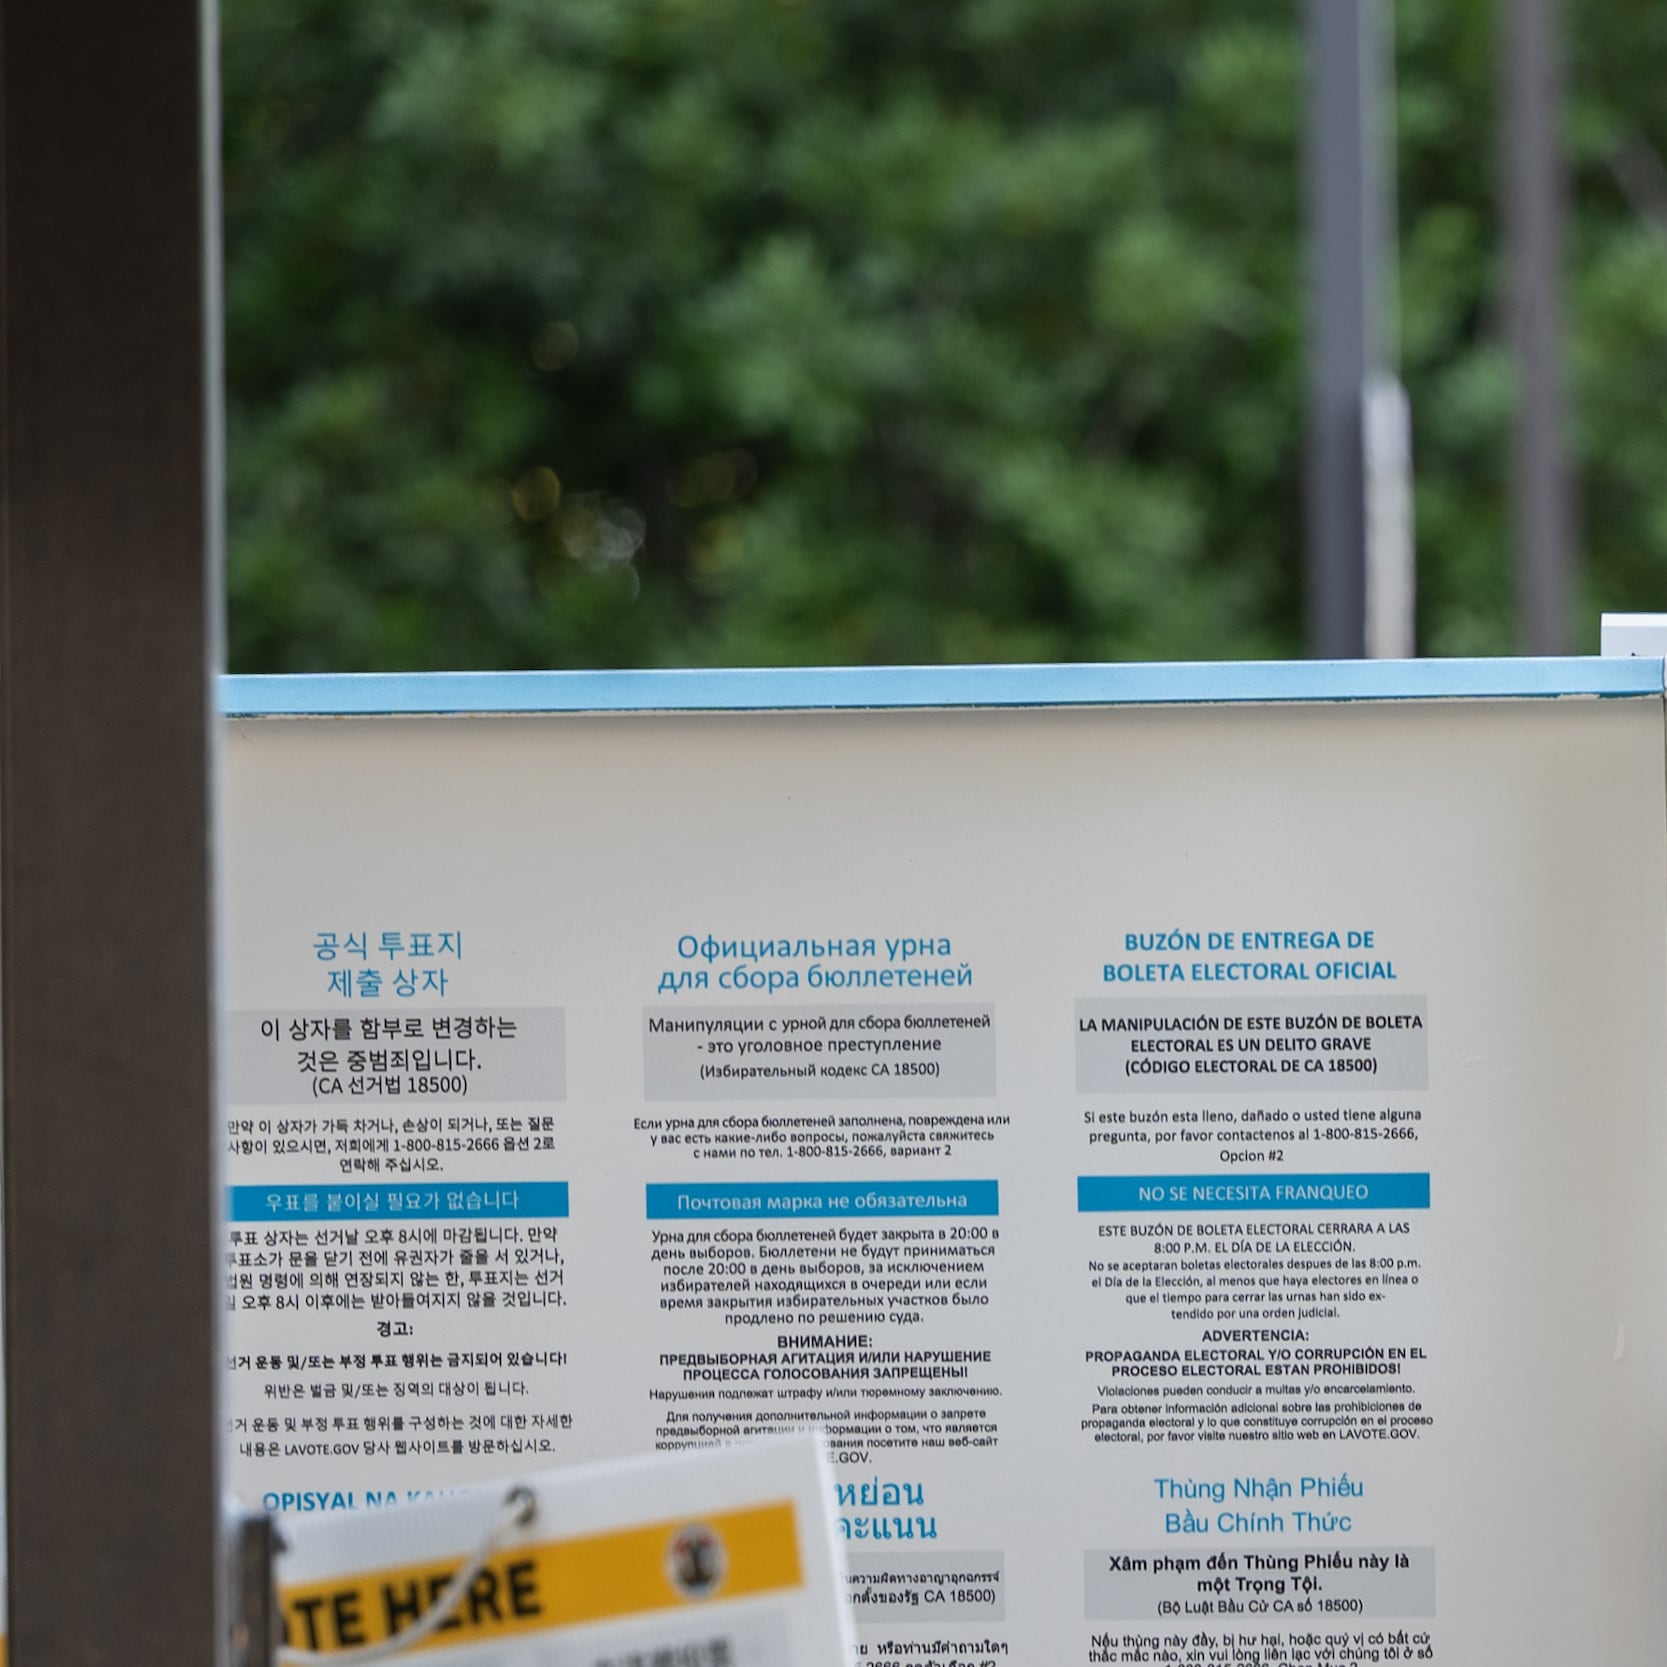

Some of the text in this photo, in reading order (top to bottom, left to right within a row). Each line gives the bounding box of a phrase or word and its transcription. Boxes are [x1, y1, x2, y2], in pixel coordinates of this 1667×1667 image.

[313, 930, 463, 961] 공식 투표지
[677, 933, 952, 964] Официальная урна
[1125, 927, 1375, 951] BUZÓN DE ENTREGA DE
[657, 962, 973, 994] для сбора бюллетеней
[1103, 960, 1398, 982] BOLETA ELECTORAL OFICIAL
[328, 967, 450, 998] 제출 상자
[261, 1014, 518, 1042] 이 상자를 함부로 변경하는
[649, 1016, 765, 1035] Манипуляции
[781, 1015, 828, 1033] урной
[829, 1017, 856, 1032] для
[858, 1013, 902, 1033] сбора
[903, 1013, 992, 1029] бюллетеней
[1079, 1012, 1424, 1032] LA MANIPULACIÓN DE ESTE BUZÓN DE BOLETA
[708, 1038, 943, 1056] это уголовное преступление
[1131, 1036, 1373, 1053] ELECTORAL ES UN DELITO GRAVE
[297, 1047, 483, 1073] 것은 중범죄입니다.
[700, 1060, 941, 1080] (Избирательный кодекс CA 18500)
[1125, 1056, 1379, 1077] (CÓDIGO ELECTORAL DE CA 18500)
[312, 1073, 469, 1098] (CA 선거법 18500)
[1098, 1111, 1127, 1124] este
[1129, 1109, 1170, 1123] buzón
[1172, 1110, 1199, 1123] esta
[1202, 1108, 1238, 1124] lleno,
[1240, 1108, 1290, 1122] dañado
[1292, 1111, 1302, 1122] o
[1304, 1107, 1341, 1122] usted
[1343, 1108, 1377, 1121] tiene
[1379, 1106, 1423, 1124] alguna
[1089, 1126, 1419, 1145] pregunta, por favor contactenos al 1-800-815-2666,
[1219, 1148, 1285, 1164] Opcion #2
[677, 1190, 968, 1213] Почтовая марка не обязательна
[1139, 1183, 1370, 1201] NO SE NECESITA FRANQUEO
[1098, 1221, 1411, 1237] ESTE BUZÓN DE BOLETA ELECTORAL CERRARA A LAS
[376, 1319, 414, 1338] 경고:
[1201, 1328, 1310, 1342] ADVERTENCIA:
[777, 1333, 874, 1349] ВНИМАНИЕ:
[1085, 1345, 1428, 1362] PROPAGANDA ELECTORAL Y/O CORRUPCIÓN EN EL
[1111, 1361, 1402, 1377] PROCESO ELECTORAL ESTAN PROHIBIDOS!
[1154, 1472, 1365, 1503] Thùng Nhận Phiếu
[262, 1492, 355, 1512] OPISYAL
[1165, 1508, 1353, 1534] Bầu Chính Thức
[382, 1558, 542, 1642] HERE
